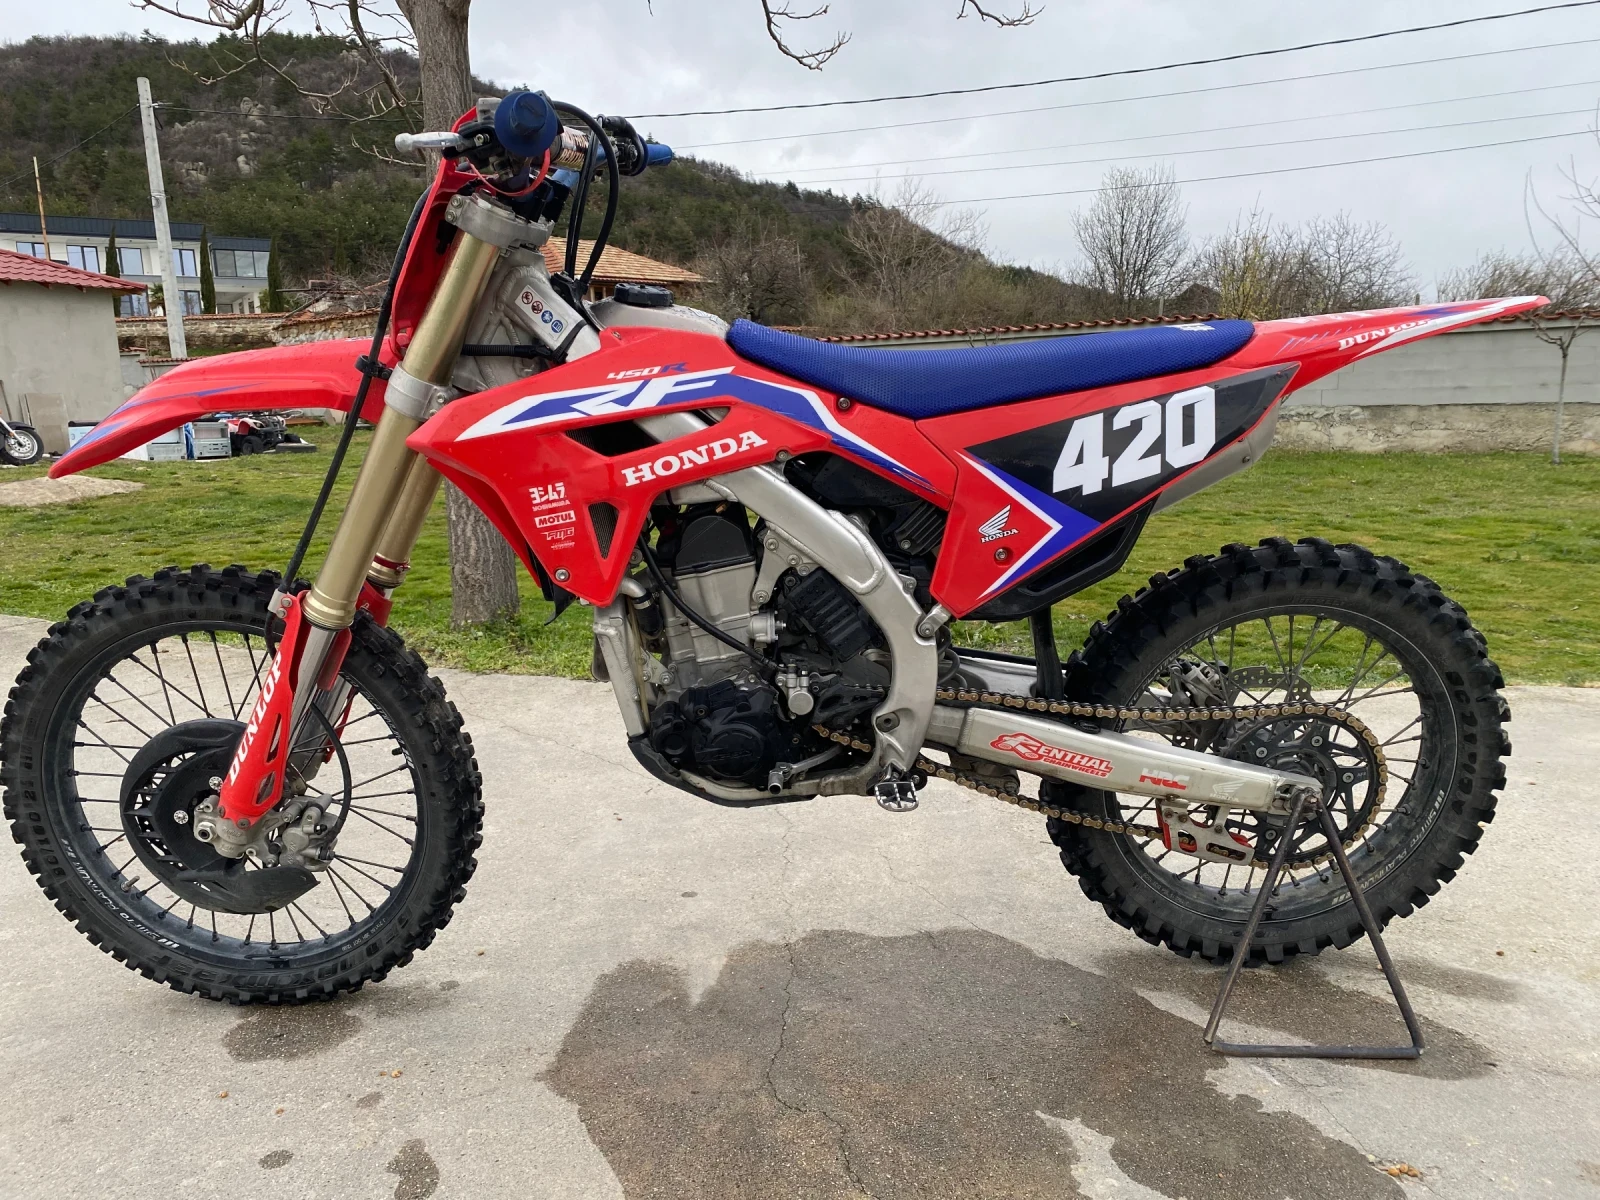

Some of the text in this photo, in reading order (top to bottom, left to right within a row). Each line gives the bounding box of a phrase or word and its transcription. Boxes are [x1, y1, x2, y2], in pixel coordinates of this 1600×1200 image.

[607, 362, 689, 380] 450R
[1053, 385, 1216, 496] 420
[621, 430, 768, 487] HONDA
[538, 512, 574, 526] MOTUL
[980, 527, 1019, 543] HONDA
[229, 651, 282, 787] DUNLOP
[1002, 735, 1113, 772] RENTHAL
[1043, 757, 1108, 778] CHAINWHEELS
[1139, 767, 1190, 790] HRC
